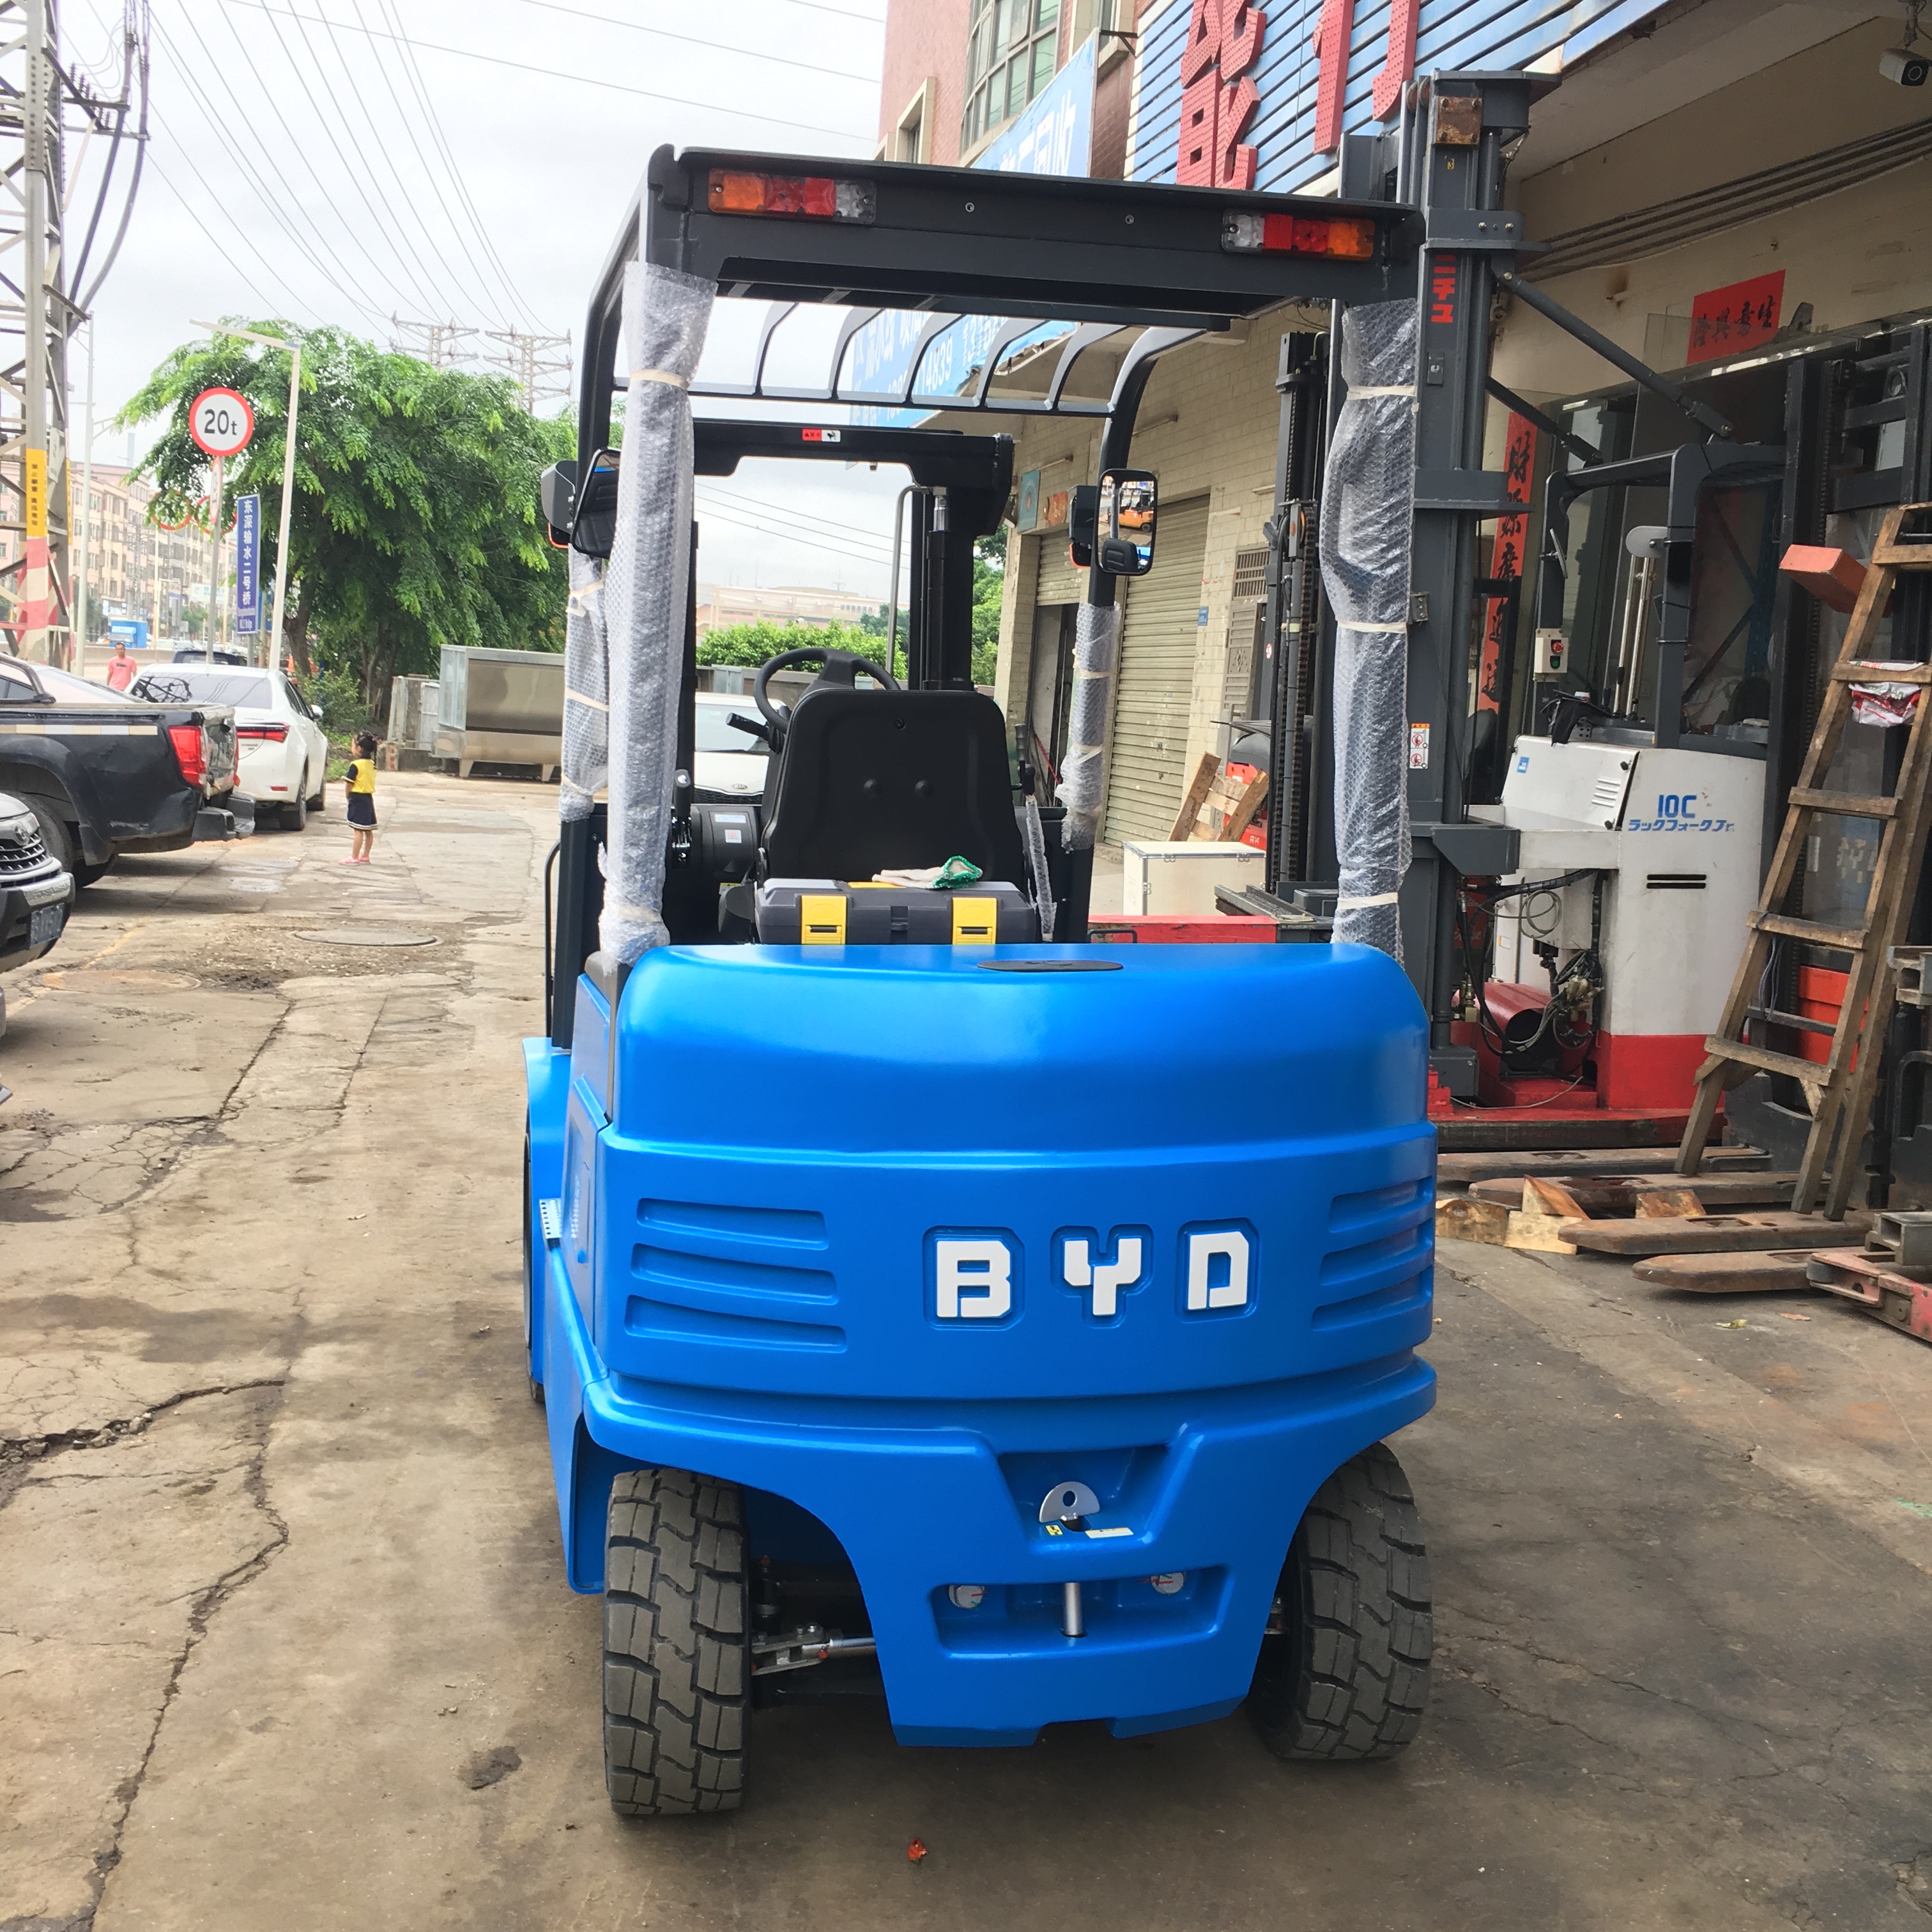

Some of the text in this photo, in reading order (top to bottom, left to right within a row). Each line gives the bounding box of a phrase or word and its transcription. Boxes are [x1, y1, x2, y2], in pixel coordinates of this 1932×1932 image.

[204, 409, 237, 436] 20t
[242, 499, 253, 606] 东深输水二号桥
[936, 1230, 1249, 1318] BYD
